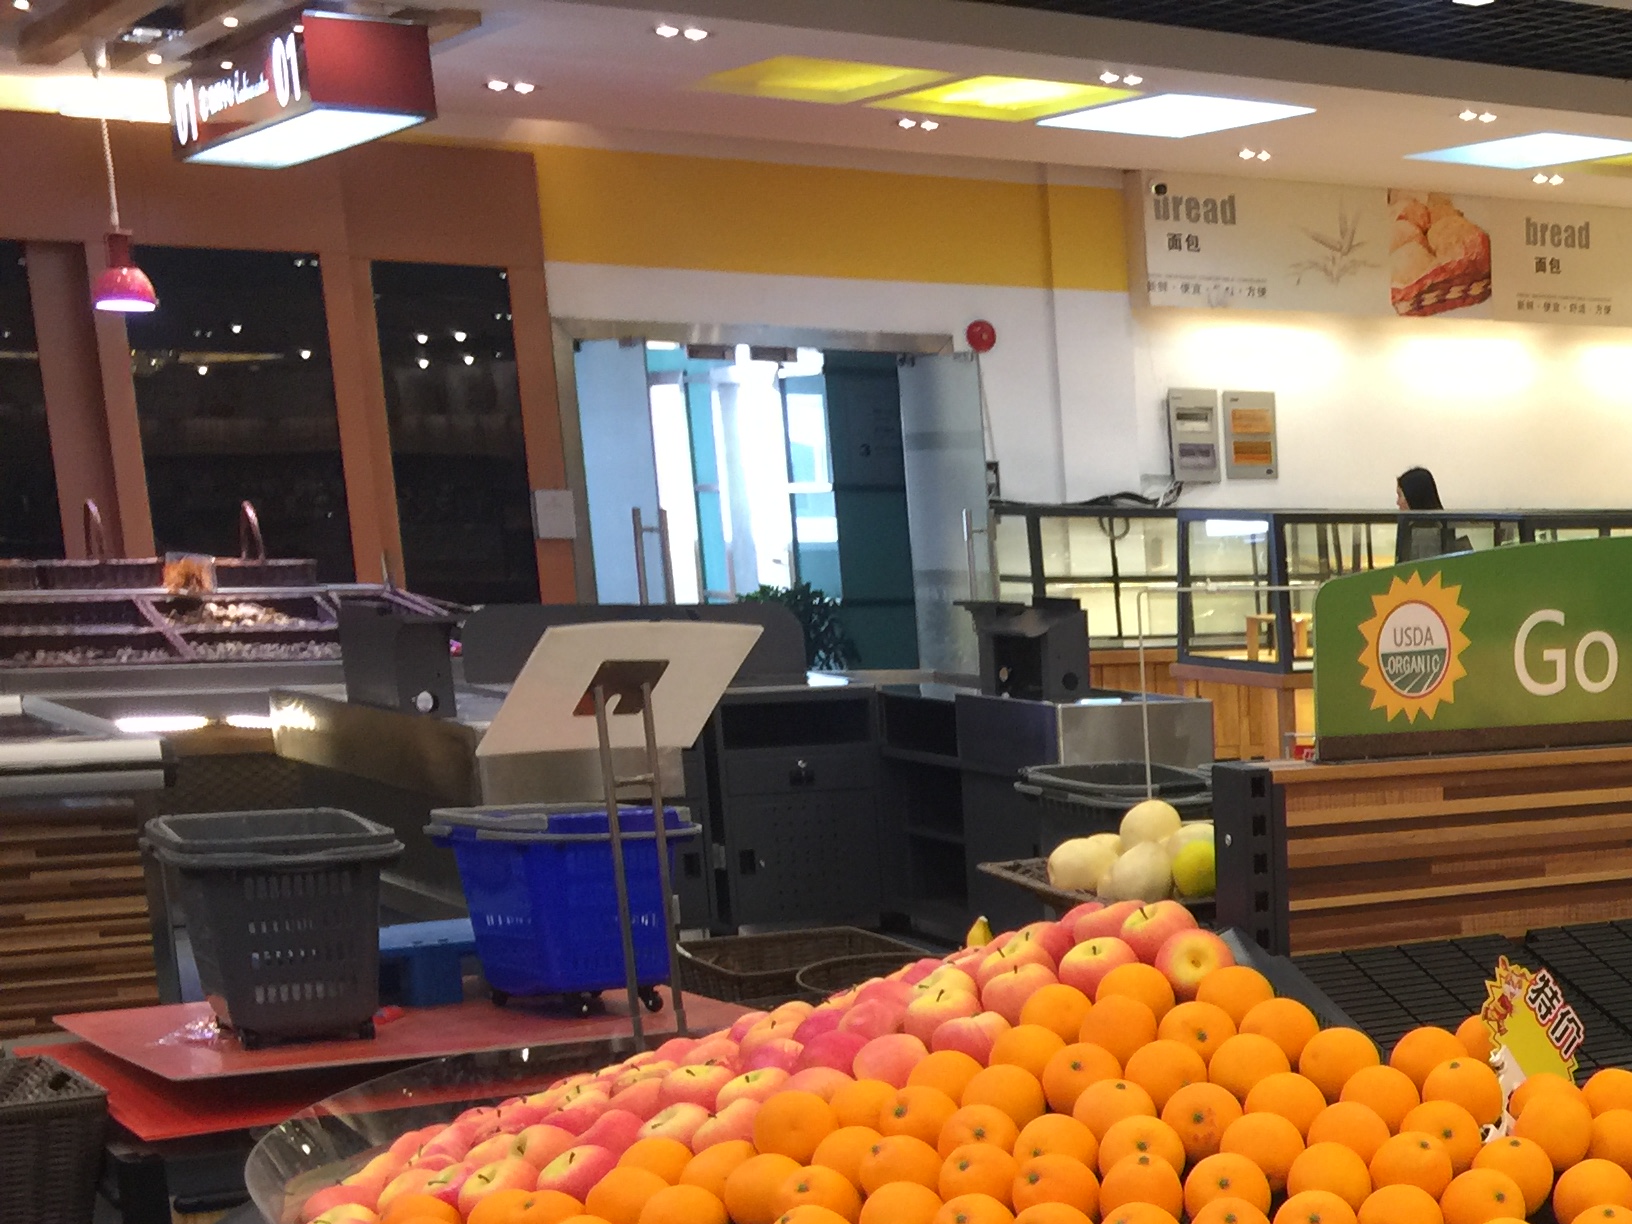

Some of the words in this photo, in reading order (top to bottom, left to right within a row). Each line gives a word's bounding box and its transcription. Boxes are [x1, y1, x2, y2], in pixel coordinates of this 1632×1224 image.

[272, 32, 301, 108] 01
[1152, 193, 1236, 225] bread
[1166, 232, 1201, 253] 面包
[1525, 216, 1590, 250] bread
[1534, 256, 1562, 274] 面包
[1393, 626, 1434, 647] USDA
[1387, 654, 1440, 675] ORGANIC
[1514, 609, 1619, 697] Go
[1526, 971, 1584, 1058] 特价
